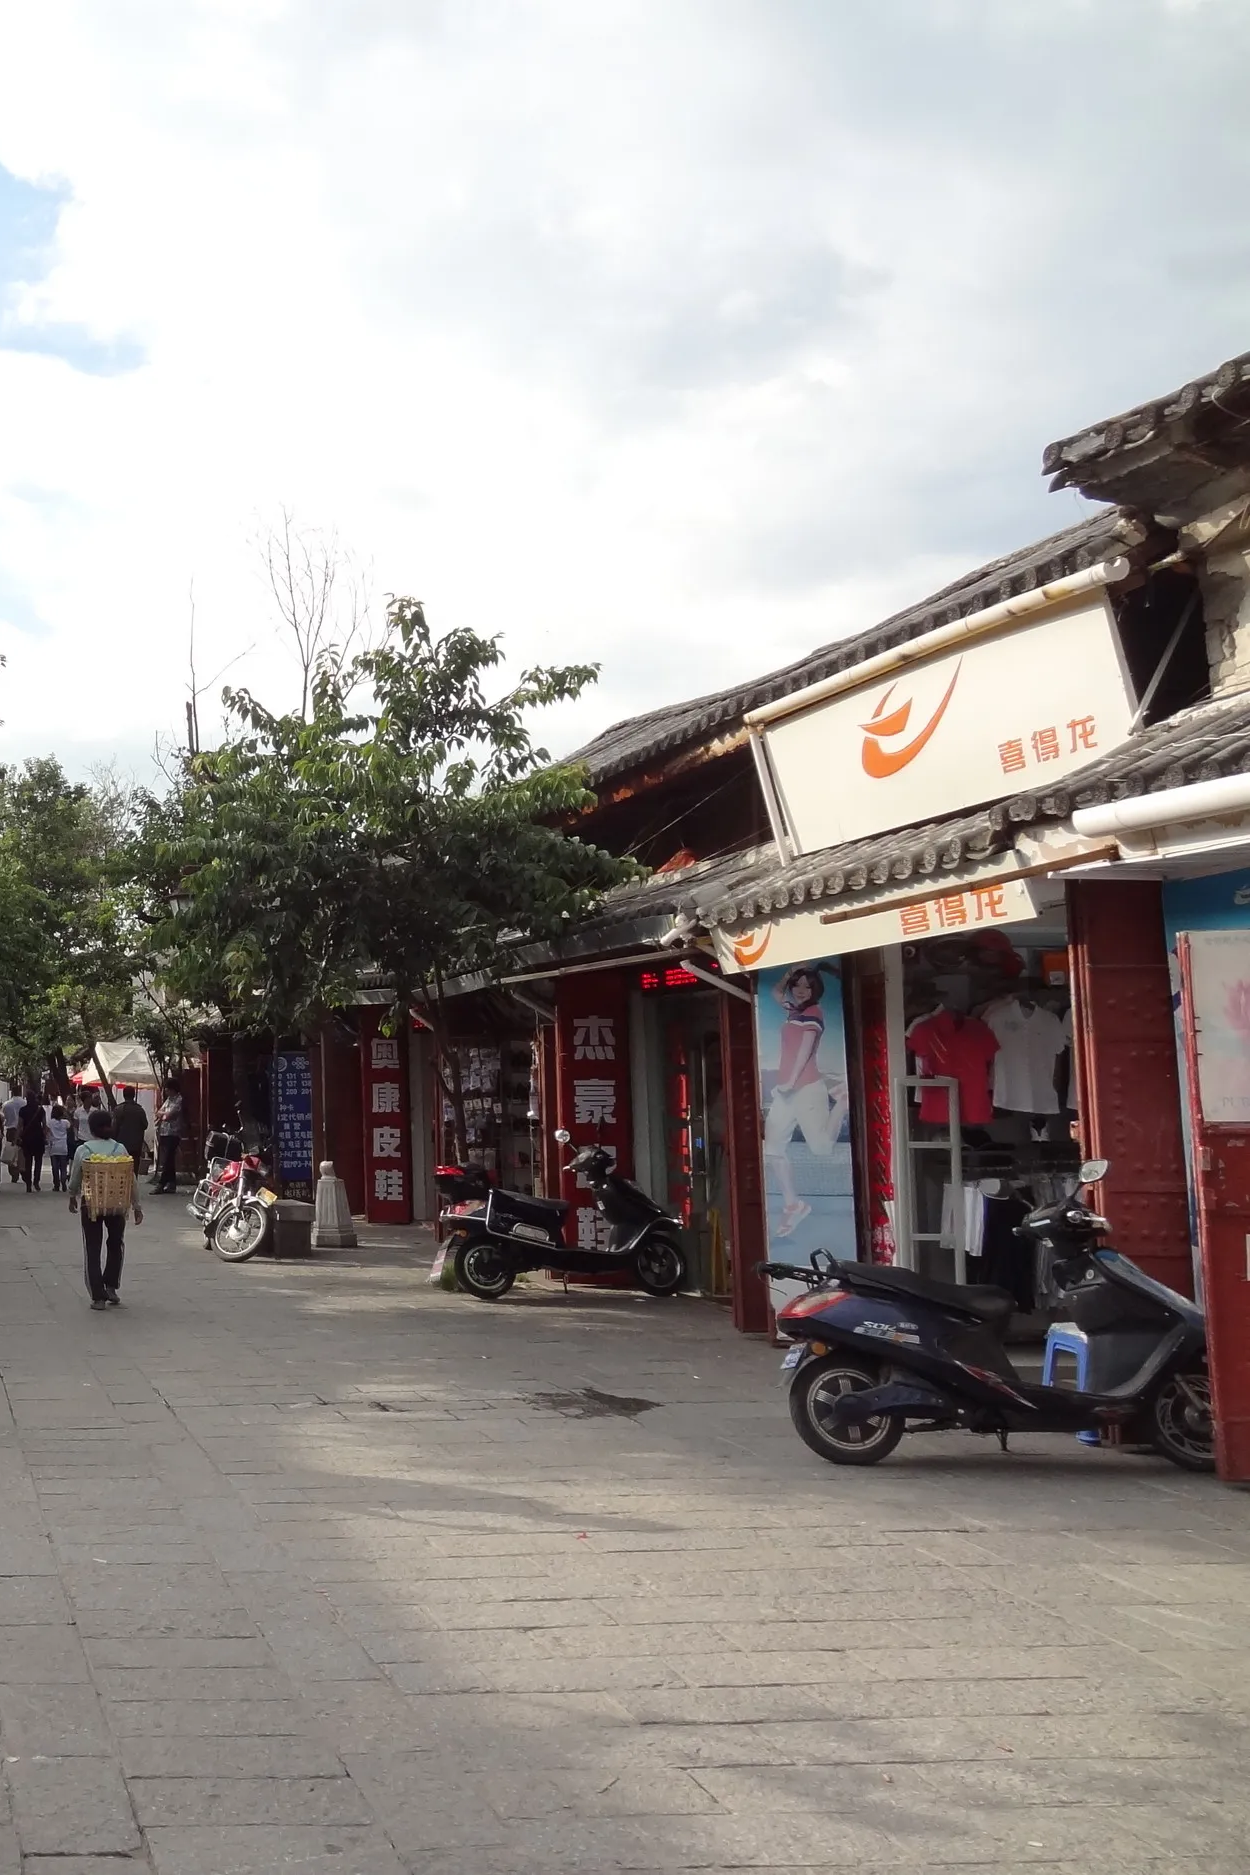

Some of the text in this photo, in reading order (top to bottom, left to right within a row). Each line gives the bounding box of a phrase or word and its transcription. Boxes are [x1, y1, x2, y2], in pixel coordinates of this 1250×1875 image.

[997, 715, 1099, 774] 喜得龙
[900, 884, 1009, 936] 喜得龙
[371, 1037, 404, 1201] 奥康皮鞋
[573, 1015, 618, 1251] 杰豪鞋
